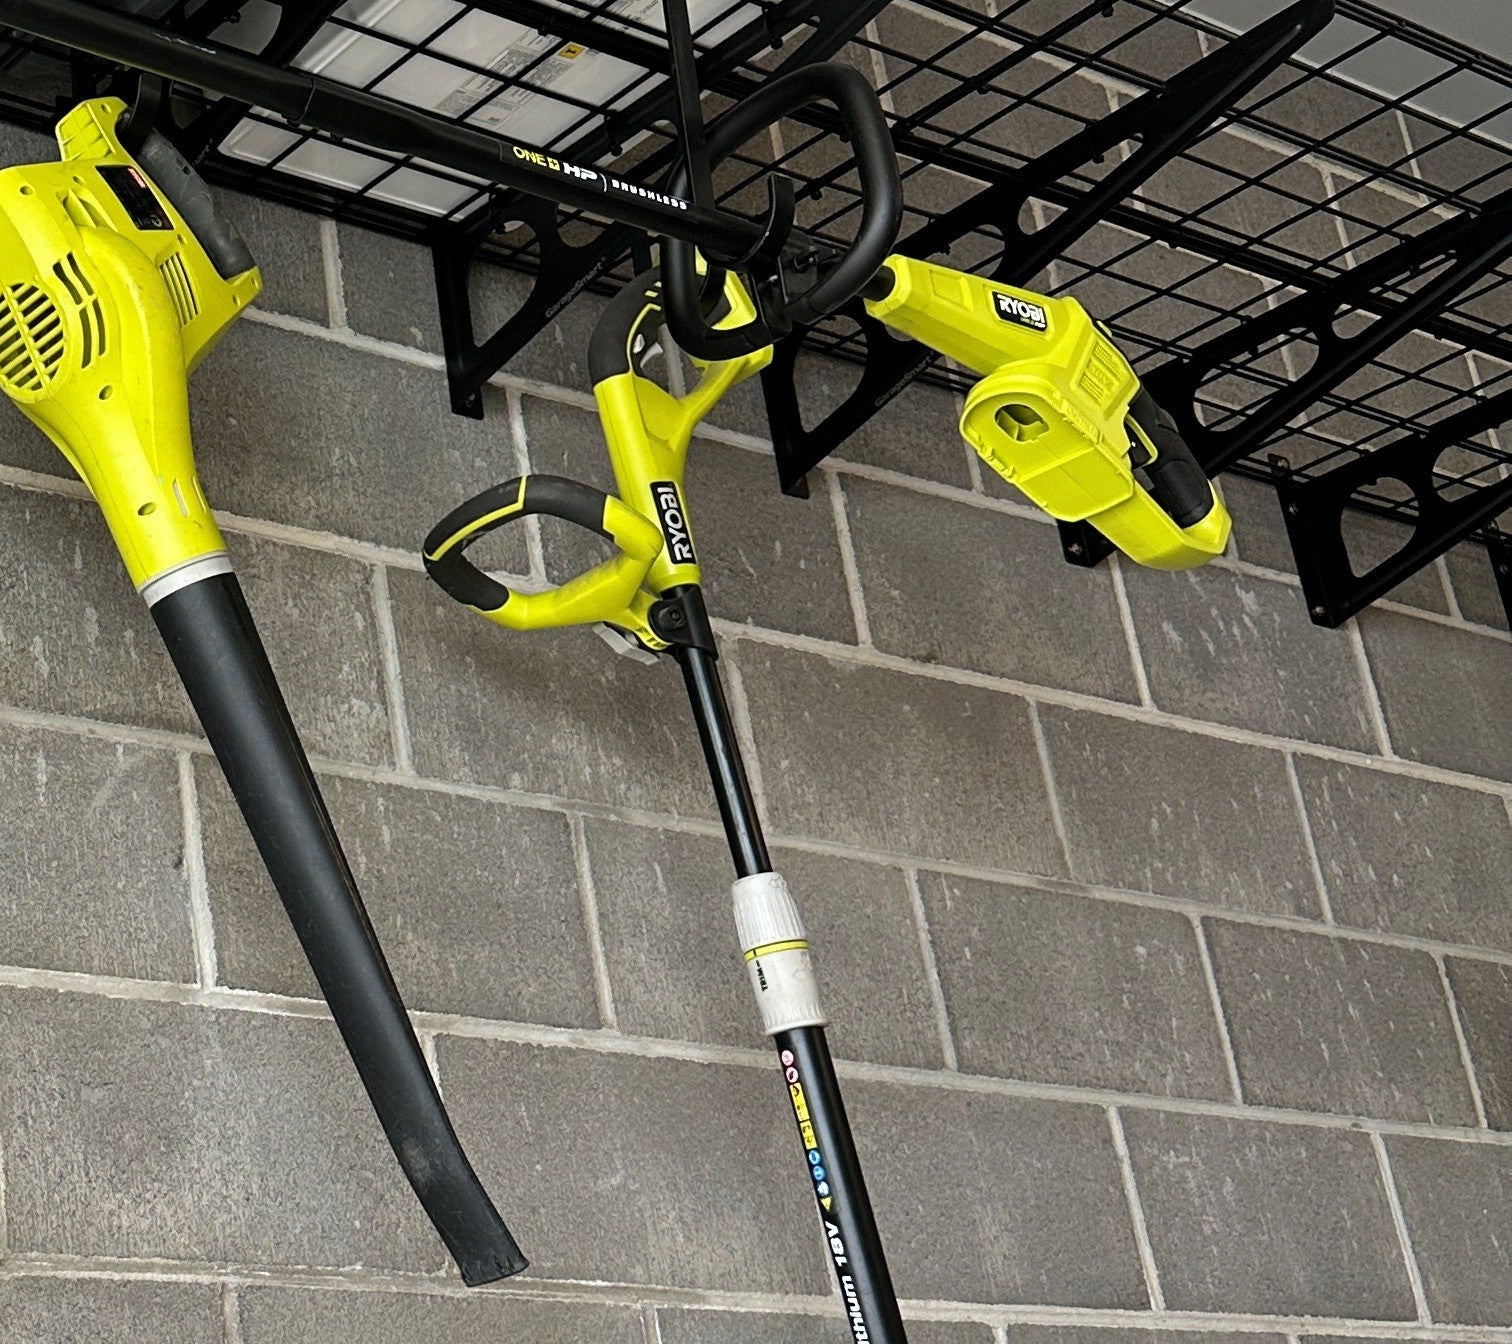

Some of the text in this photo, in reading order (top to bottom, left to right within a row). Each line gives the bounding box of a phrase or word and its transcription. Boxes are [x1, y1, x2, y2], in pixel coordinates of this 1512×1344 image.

[563, 162, 599, 181] HP
[611, 179, 688, 211] BRUSHLESS
[996, 294, 1046, 324] RYOBI
[656, 487, 693, 561] RYOBI
[824, 1220, 848, 1267] 18V
